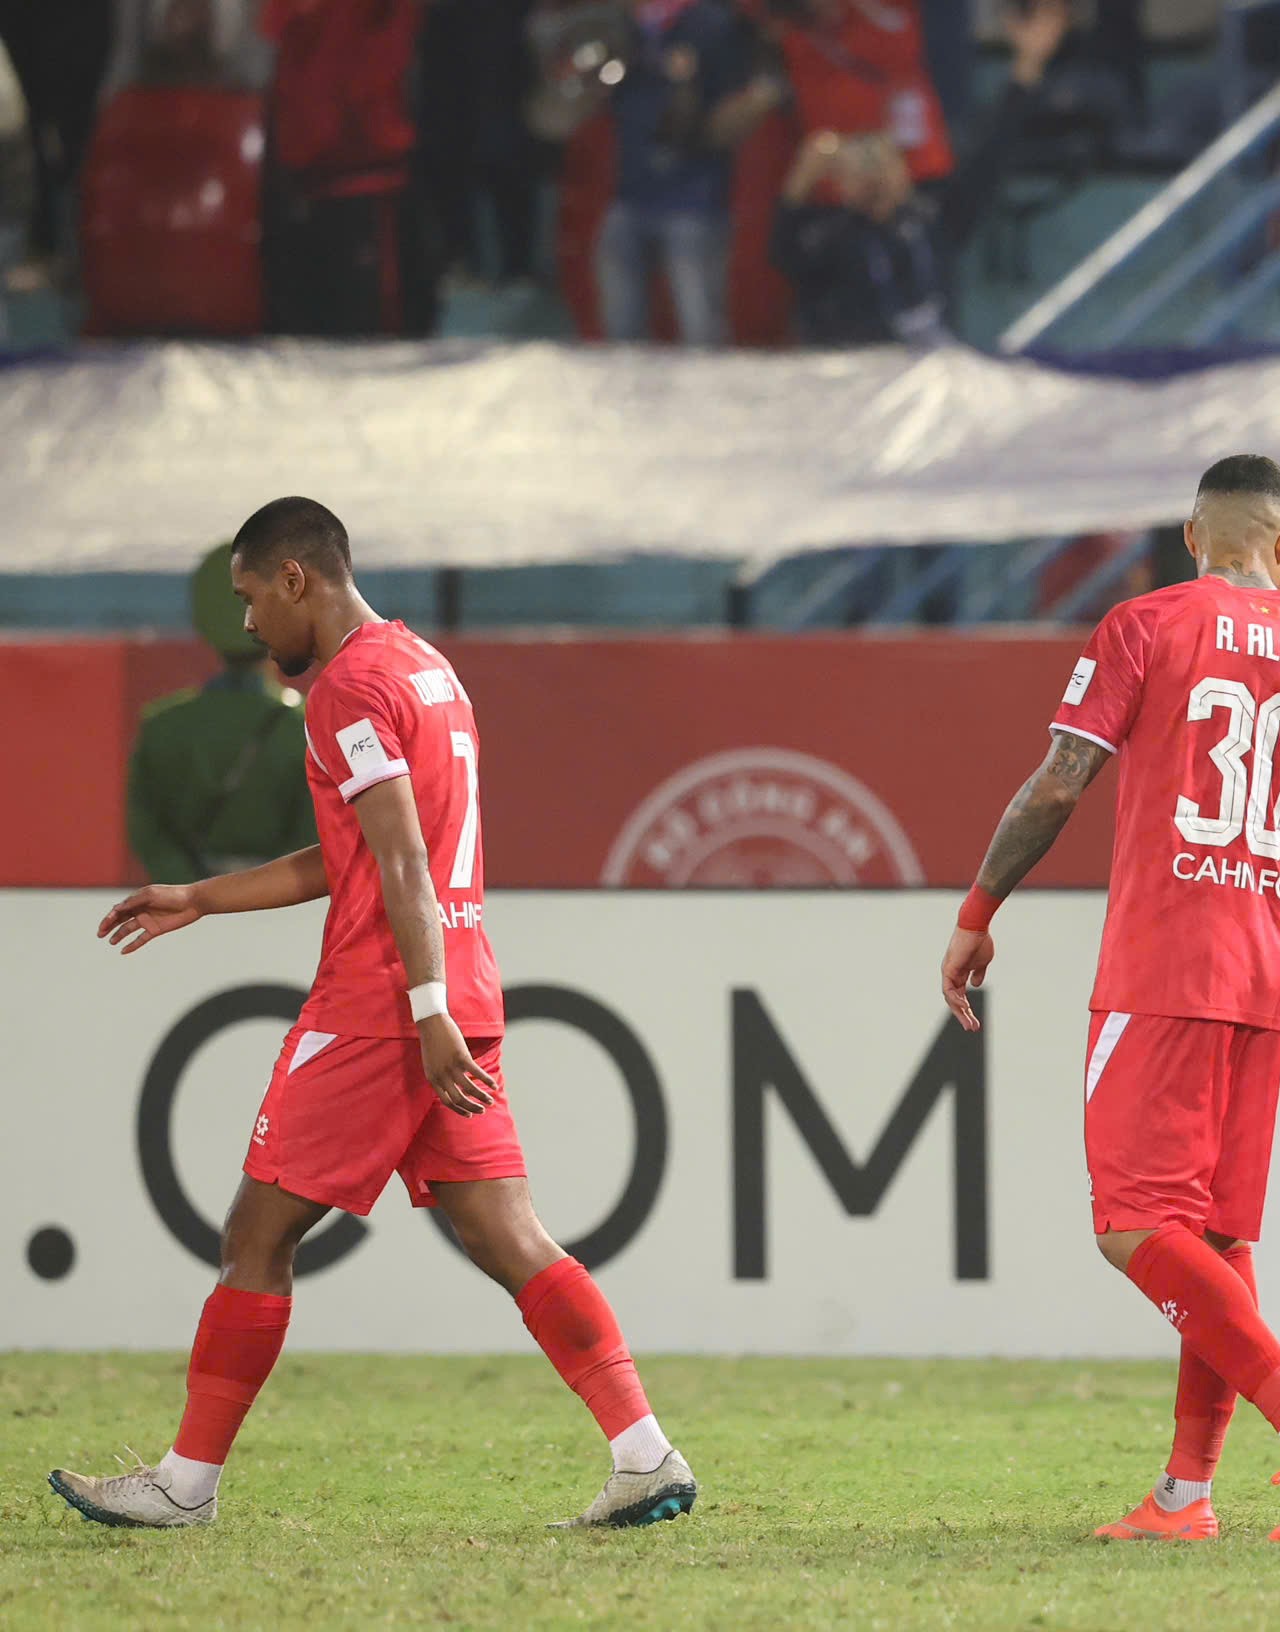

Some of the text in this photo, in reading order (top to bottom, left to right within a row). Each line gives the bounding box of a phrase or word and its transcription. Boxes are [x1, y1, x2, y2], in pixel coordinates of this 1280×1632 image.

[1216, 615, 1239, 653] R.
[350, 736, 375, 758] AFC
[449, 731, 479, 889] 7
[436, 901, 475, 929] AHN
